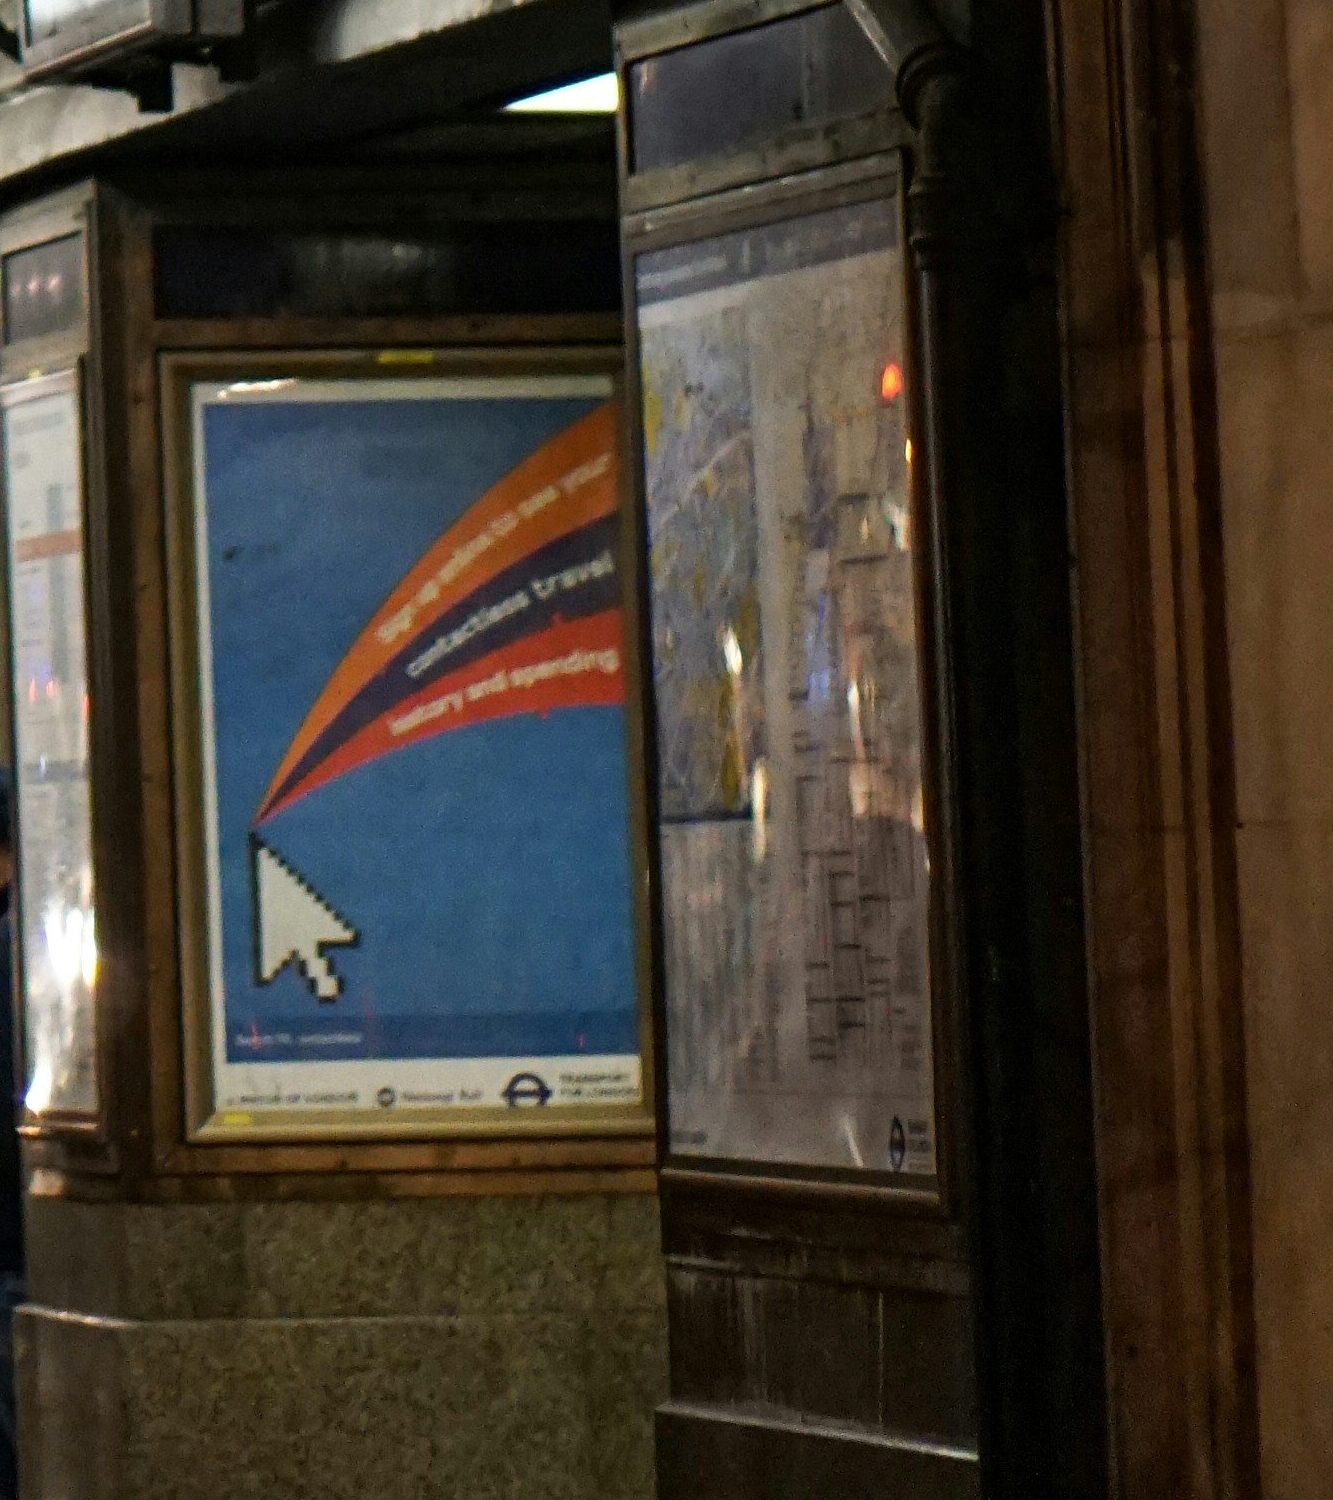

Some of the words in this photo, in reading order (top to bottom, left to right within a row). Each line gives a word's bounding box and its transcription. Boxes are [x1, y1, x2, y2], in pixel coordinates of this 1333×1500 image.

[531, 548, 614, 600] travel
[465, 668, 509, 701] and
[507, 648, 620, 688] spending
